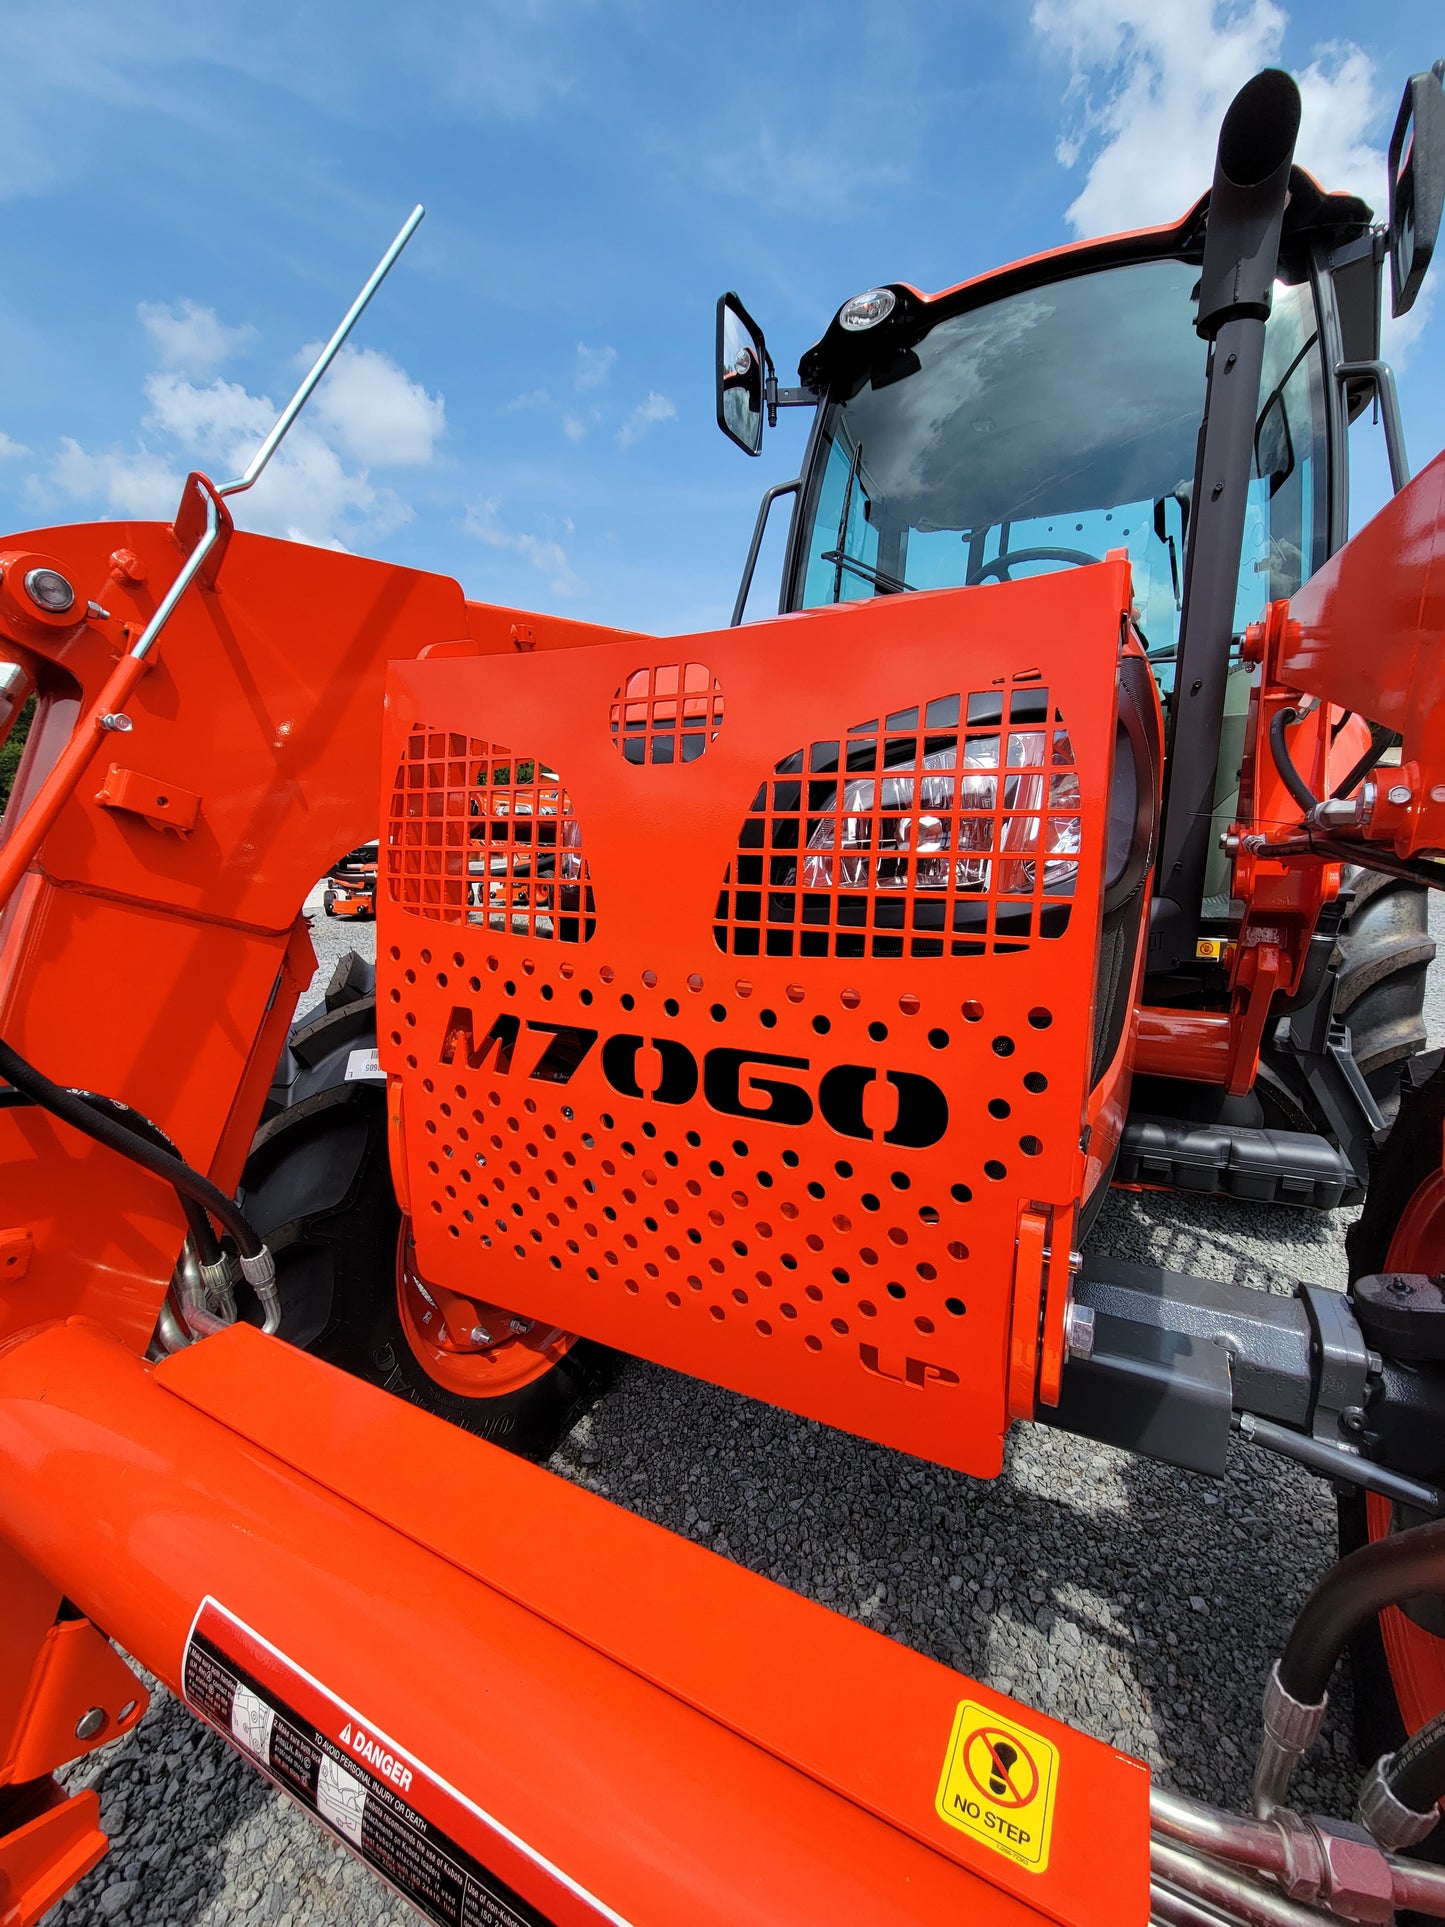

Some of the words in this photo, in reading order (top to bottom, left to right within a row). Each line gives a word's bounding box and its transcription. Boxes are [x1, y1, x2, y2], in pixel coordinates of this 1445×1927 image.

[439, 1006, 949, 1148] M7060
[858, 1341, 960, 1391] LP
[315, 1733, 322, 1744] TO
[322, 1739, 340, 1760] AVOID
[340, 1754, 371, 1786] PERSONAL
[372, 1781, 395, 1804] INJURY
[394, 1801, 405, 1814] OR
[405, 1807, 428, 1831] DEATH
[353, 1732, 413, 1792] DANGER
[363, 1808, 393, 1840] attachments
[401, 1840, 420, 1863] Kubota
[366, 1796, 383, 1818] Kubota
[383, 1812, 415, 1846] recommends
[416, 1839, 425, 1853] the
[426, 1849, 435, 1863] use
[436, 1856, 443, 1869] of
[443, 1862, 463, 1886] Kubota
[954, 1794, 981, 1819] NO
[984, 1810, 1031, 1845] STEP
[467, 1882, 478, 1898] Use
[480, 1894, 486, 1905] of
[480, 1908, 492, 1925] ISO
